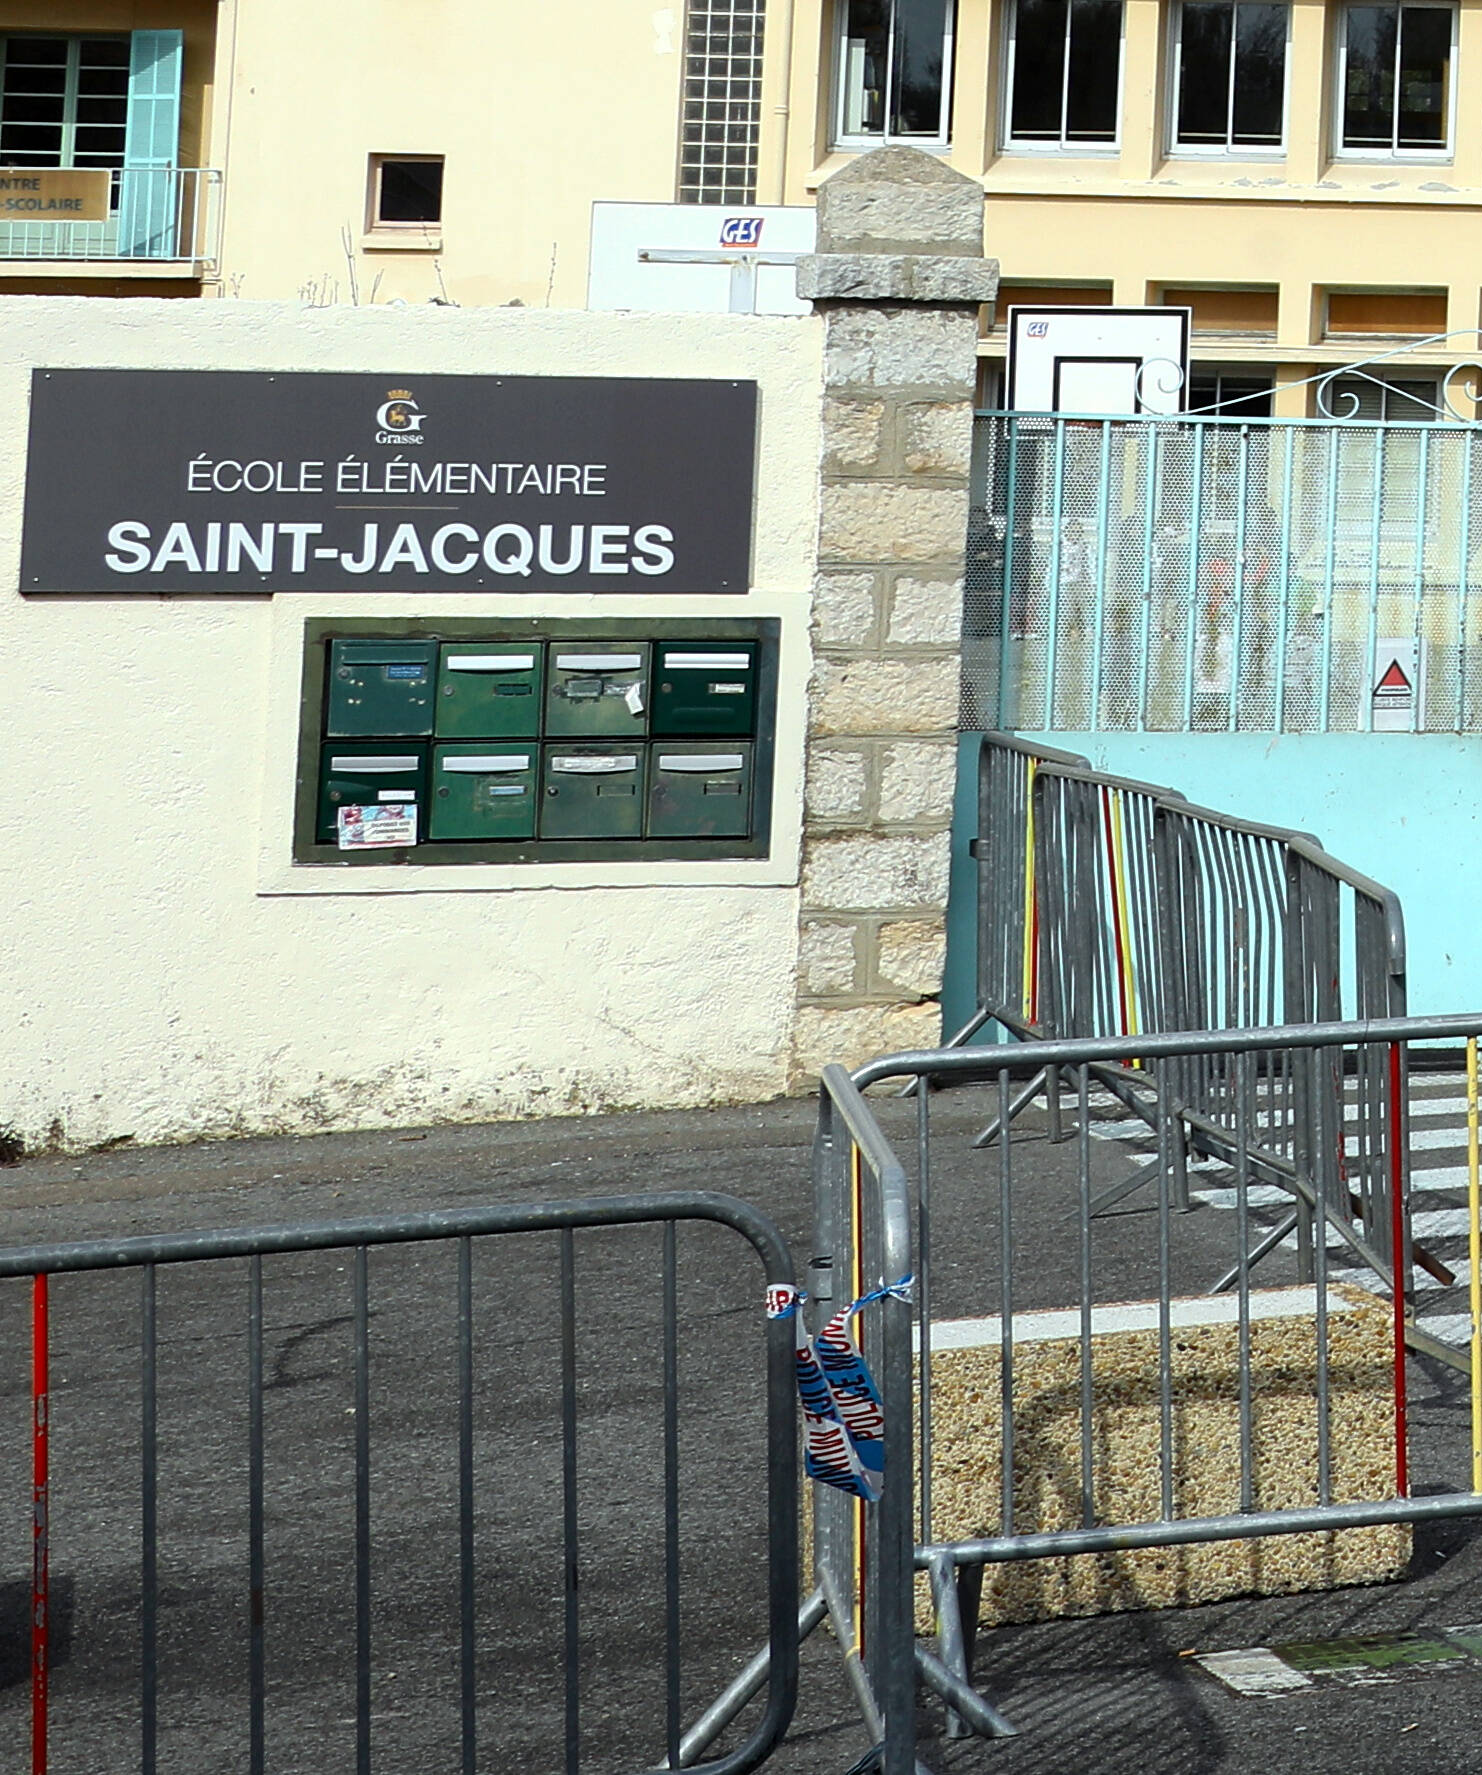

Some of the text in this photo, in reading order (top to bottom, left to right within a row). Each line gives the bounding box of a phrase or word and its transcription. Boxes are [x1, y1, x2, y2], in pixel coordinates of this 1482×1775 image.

[721, 218, 762, 244] GES
[375, 430, 425, 445] Grasse
[187, 451, 608, 496] ÉCOLE ÉLÉMENTAIRE
[104, 520, 675, 577] SAINT-JACQUES
[796, 1347, 837, 1425] POLICE
[831, 1374, 885, 1442] POLICE
